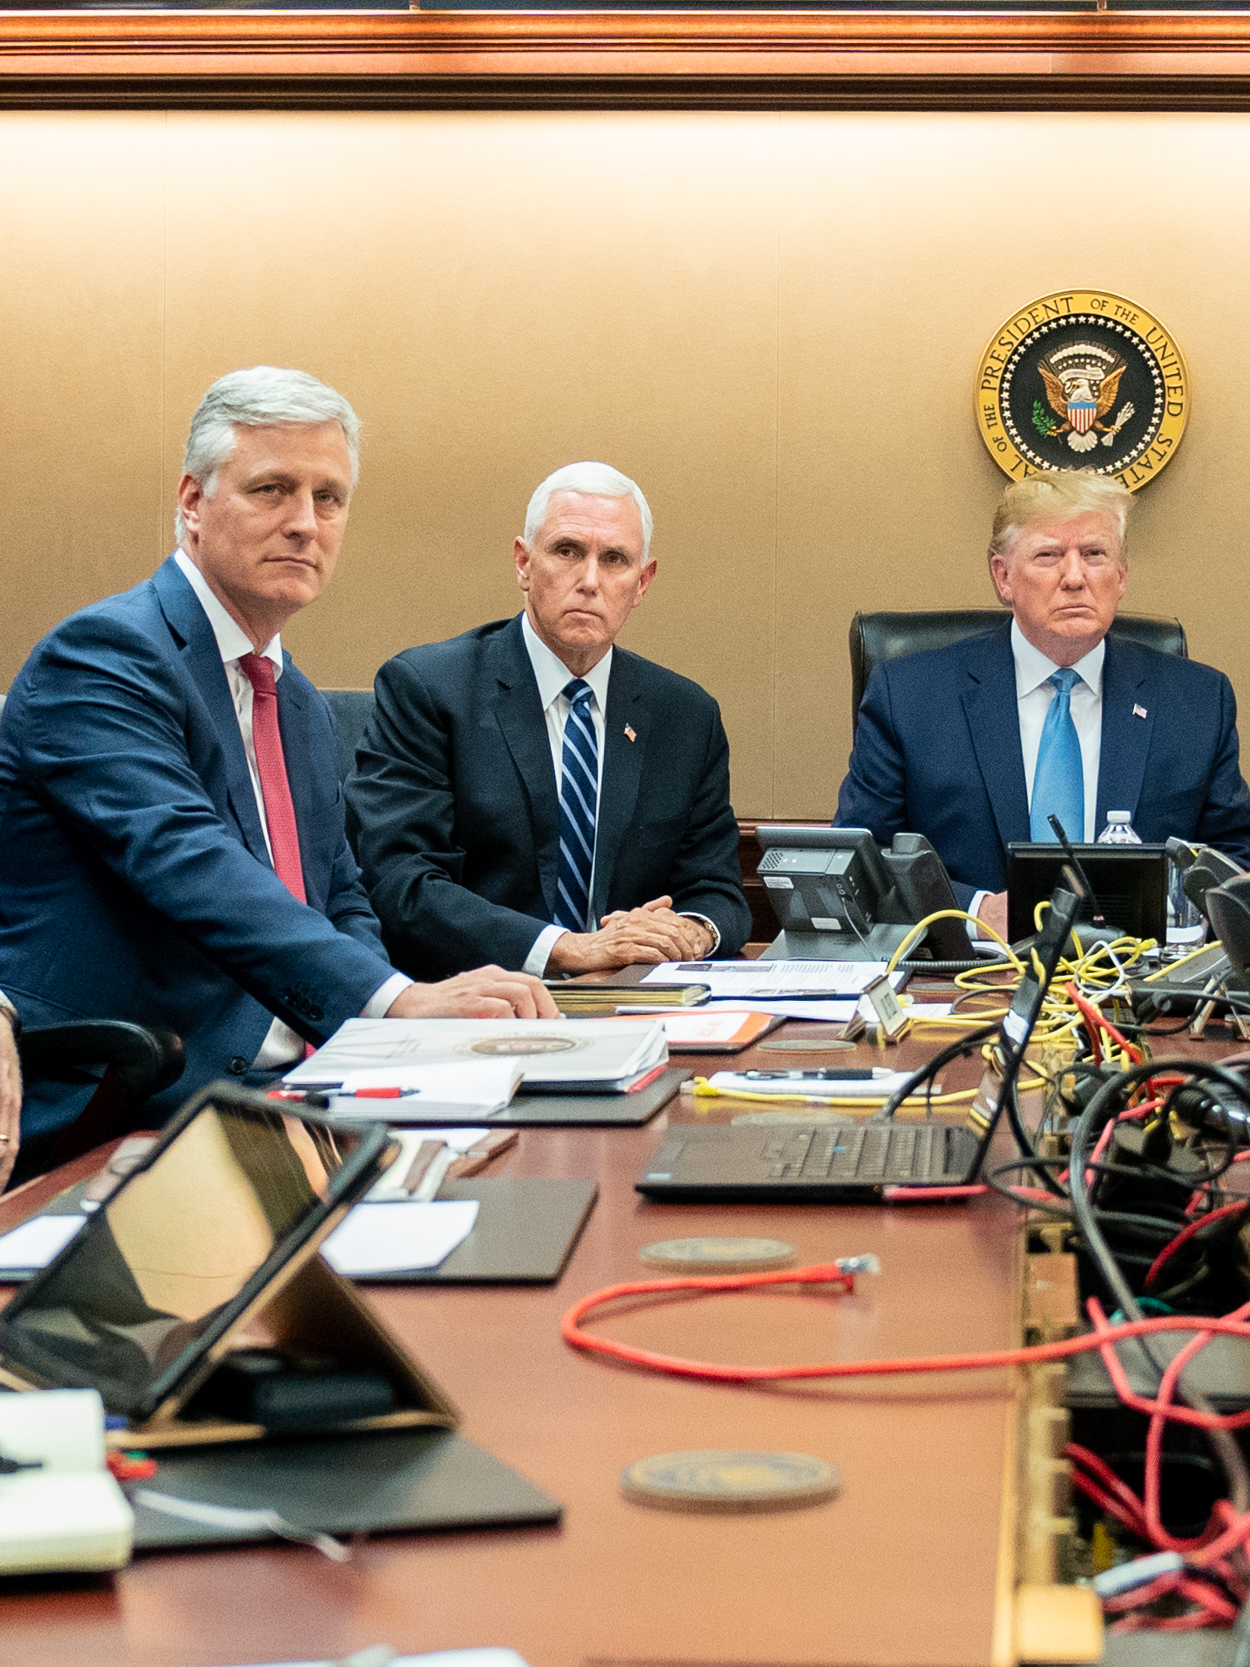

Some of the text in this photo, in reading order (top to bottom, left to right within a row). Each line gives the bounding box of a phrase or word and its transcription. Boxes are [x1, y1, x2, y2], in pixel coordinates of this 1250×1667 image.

[1090, 298, 1109, 311] OF
[1114, 304, 1140, 325] THE
[981, 296, 1074, 391] PRESIDENT
[1145, 326, 1184, 417] UNITED
[984, 404, 997, 429] THE
[992, 436, 1007, 451] OF
[1010, 454, 1037, 478] AL
[1114, 432, 1173, 489] STATE
